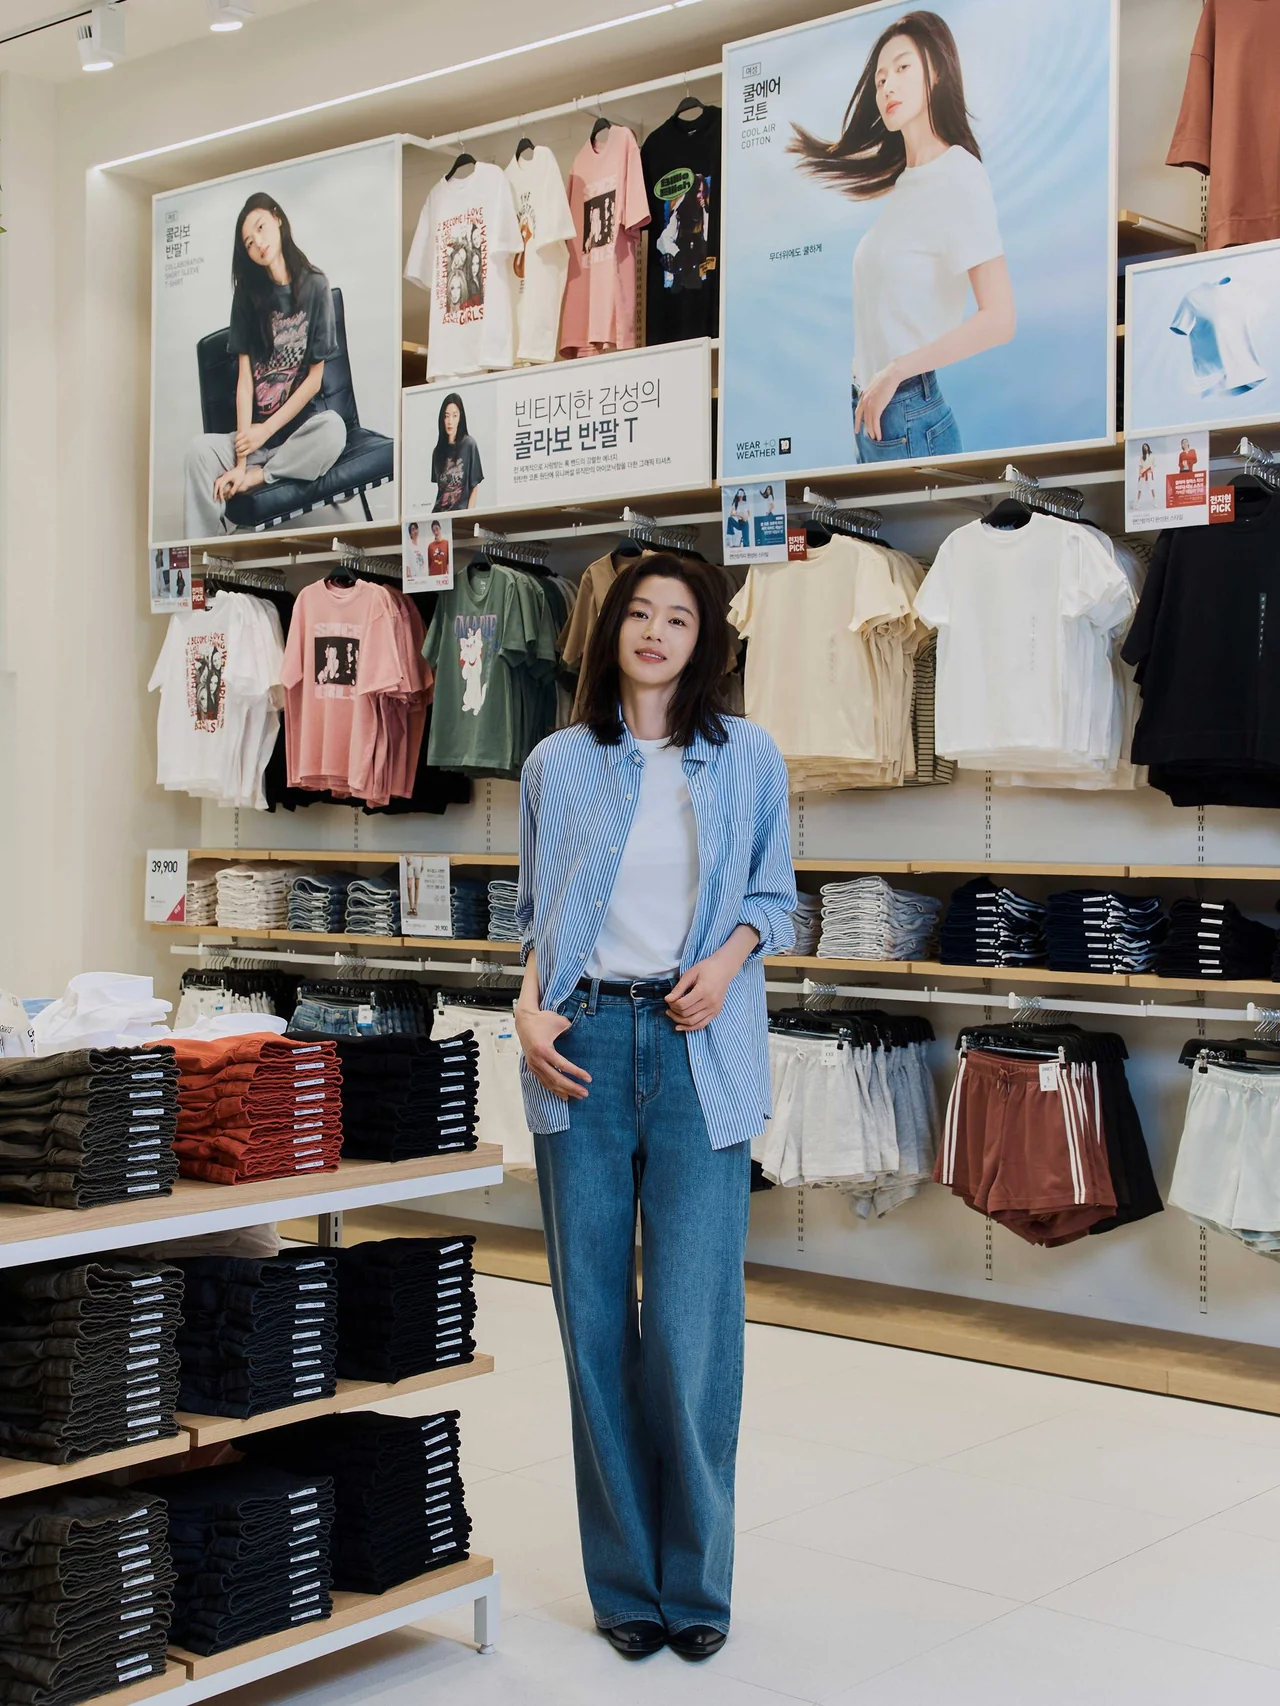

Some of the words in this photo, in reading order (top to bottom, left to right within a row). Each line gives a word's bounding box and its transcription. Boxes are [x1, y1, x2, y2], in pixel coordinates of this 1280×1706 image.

[746, 66, 758, 75] 여성
[743, 76, 780, 103] 쿨에어
[742, 102, 768, 123] 코튼
[742, 126, 760, 139] COOL
[763, 123, 776, 133] AIR
[742, 136, 771, 149] COTTON
[660, 172, 690, 188] Billie
[660, 181, 690, 198] Eilish
[467, 207, 483, 216] LOVE
[443, 214, 463, 230] BECOME
[166, 224, 190, 243] 콜라보
[166, 242, 182, 260] 반팔
[184, 241, 190, 254] T
[769, 248, 801, 262] 무더위에도
[803, 244, 822, 256] 쿨하게
[460, 308, 484, 325] GIRLS
[514, 388, 593, 427] 빈티지한
[599, 378, 661, 416] 감성의
[514, 425, 573, 460] 콜라보
[578, 418, 620, 452] 반팔
[624, 417, 638, 443] T
[736, 440, 760, 451] WEAR
[736, 448, 776, 460] WEATHER
[1210, 503, 1231, 514] PICK
[789, 543, 805, 552] PICK
[152, 860, 178, 874] 39,900
